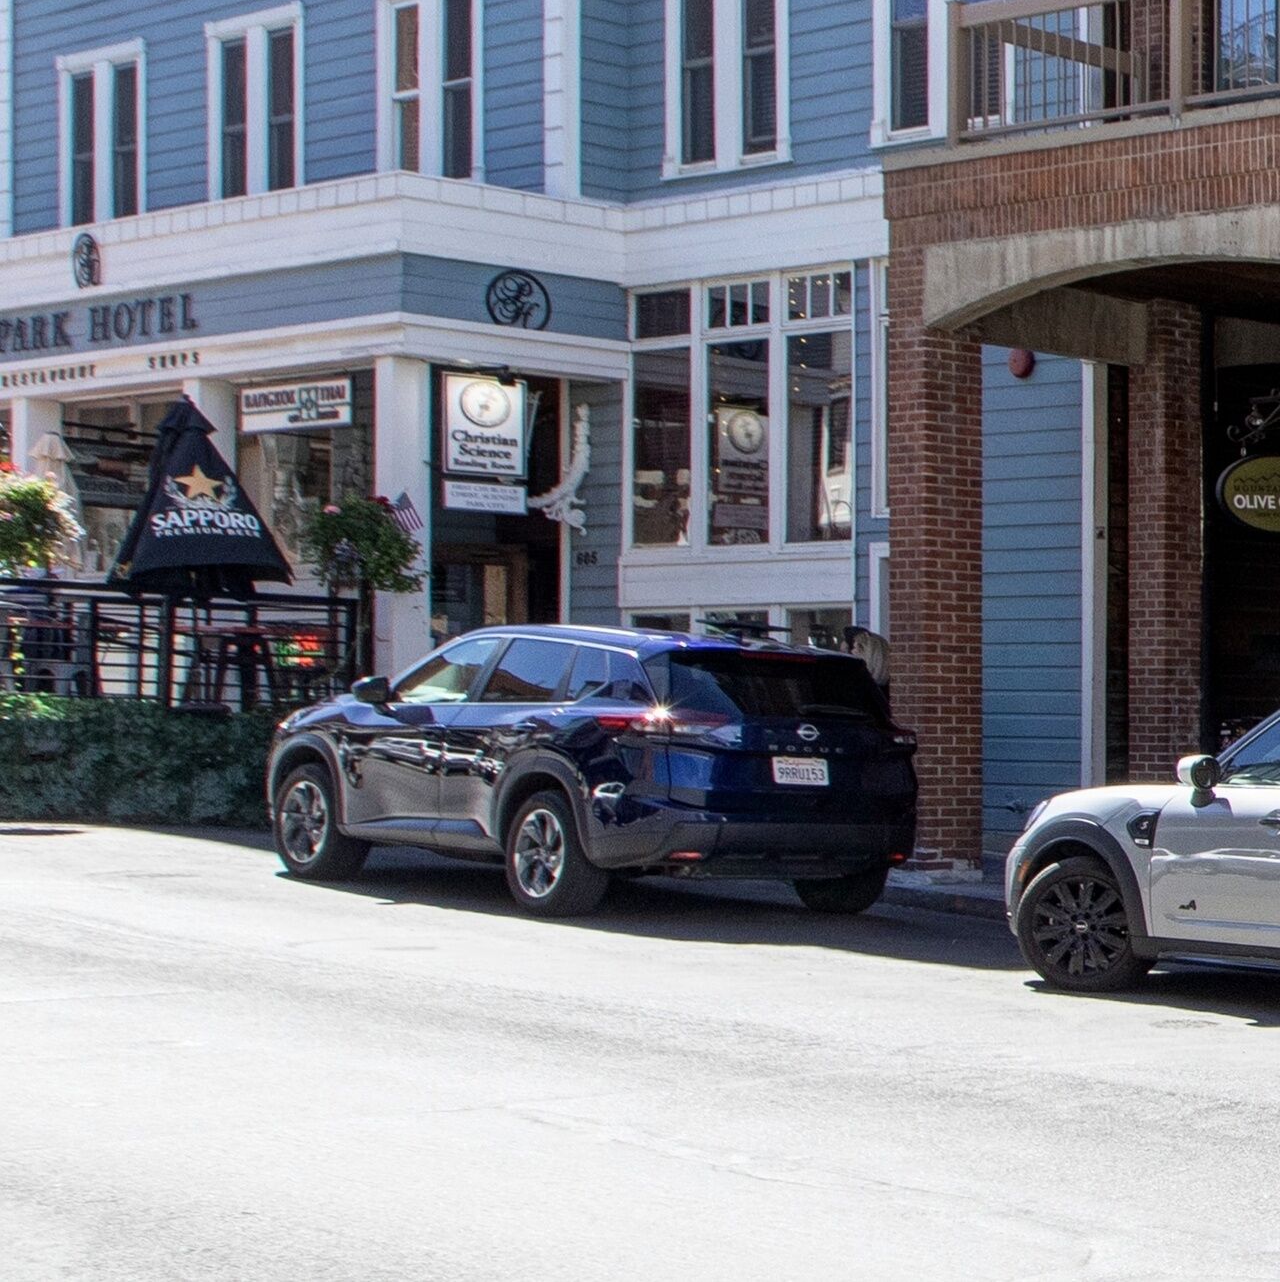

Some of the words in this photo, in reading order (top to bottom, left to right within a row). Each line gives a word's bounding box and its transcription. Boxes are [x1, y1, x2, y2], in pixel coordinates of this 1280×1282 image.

[88, 293, 199, 343] HOTEL
[452, 429, 518, 447] Christian
[458, 443, 512, 459] Science
[1233, 494, 1277, 510] OLIVE
[151, 509, 260, 531] SAPPORO
[155, 528, 224, 537] PREMIUM
[227, 529, 261, 538] BEER
[768, 744, 843, 753] ROGUE
